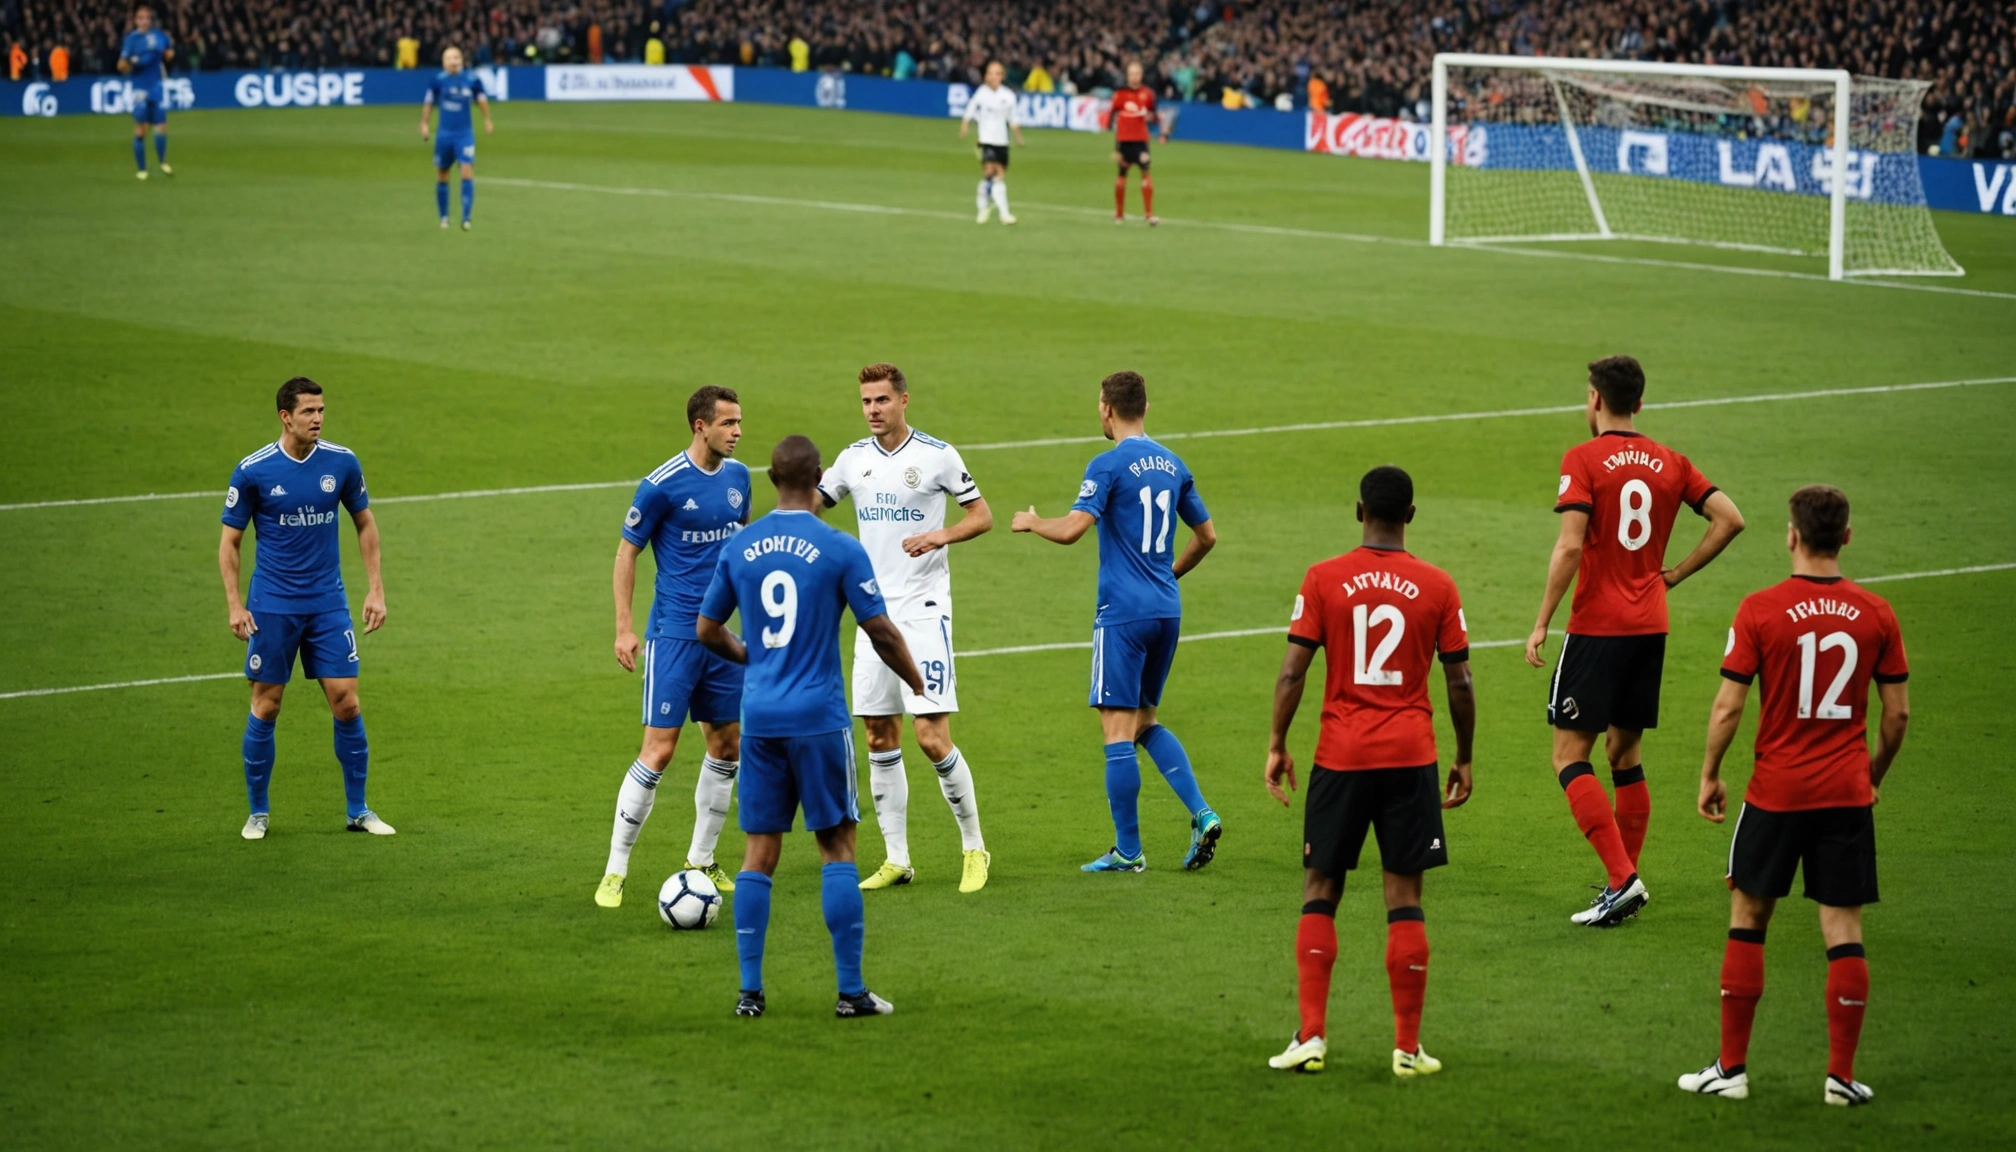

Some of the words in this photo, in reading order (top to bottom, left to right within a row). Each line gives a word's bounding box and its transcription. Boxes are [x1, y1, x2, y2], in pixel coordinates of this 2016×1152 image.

[235, 73, 364, 106] GUSPE
[1139, 485, 1171, 554] 11
[1618, 479, 1653, 551] 8
[760, 569, 799, 650] 9
[1352, 603, 1406, 686] 12
[1796, 630, 1859, 720] 12
